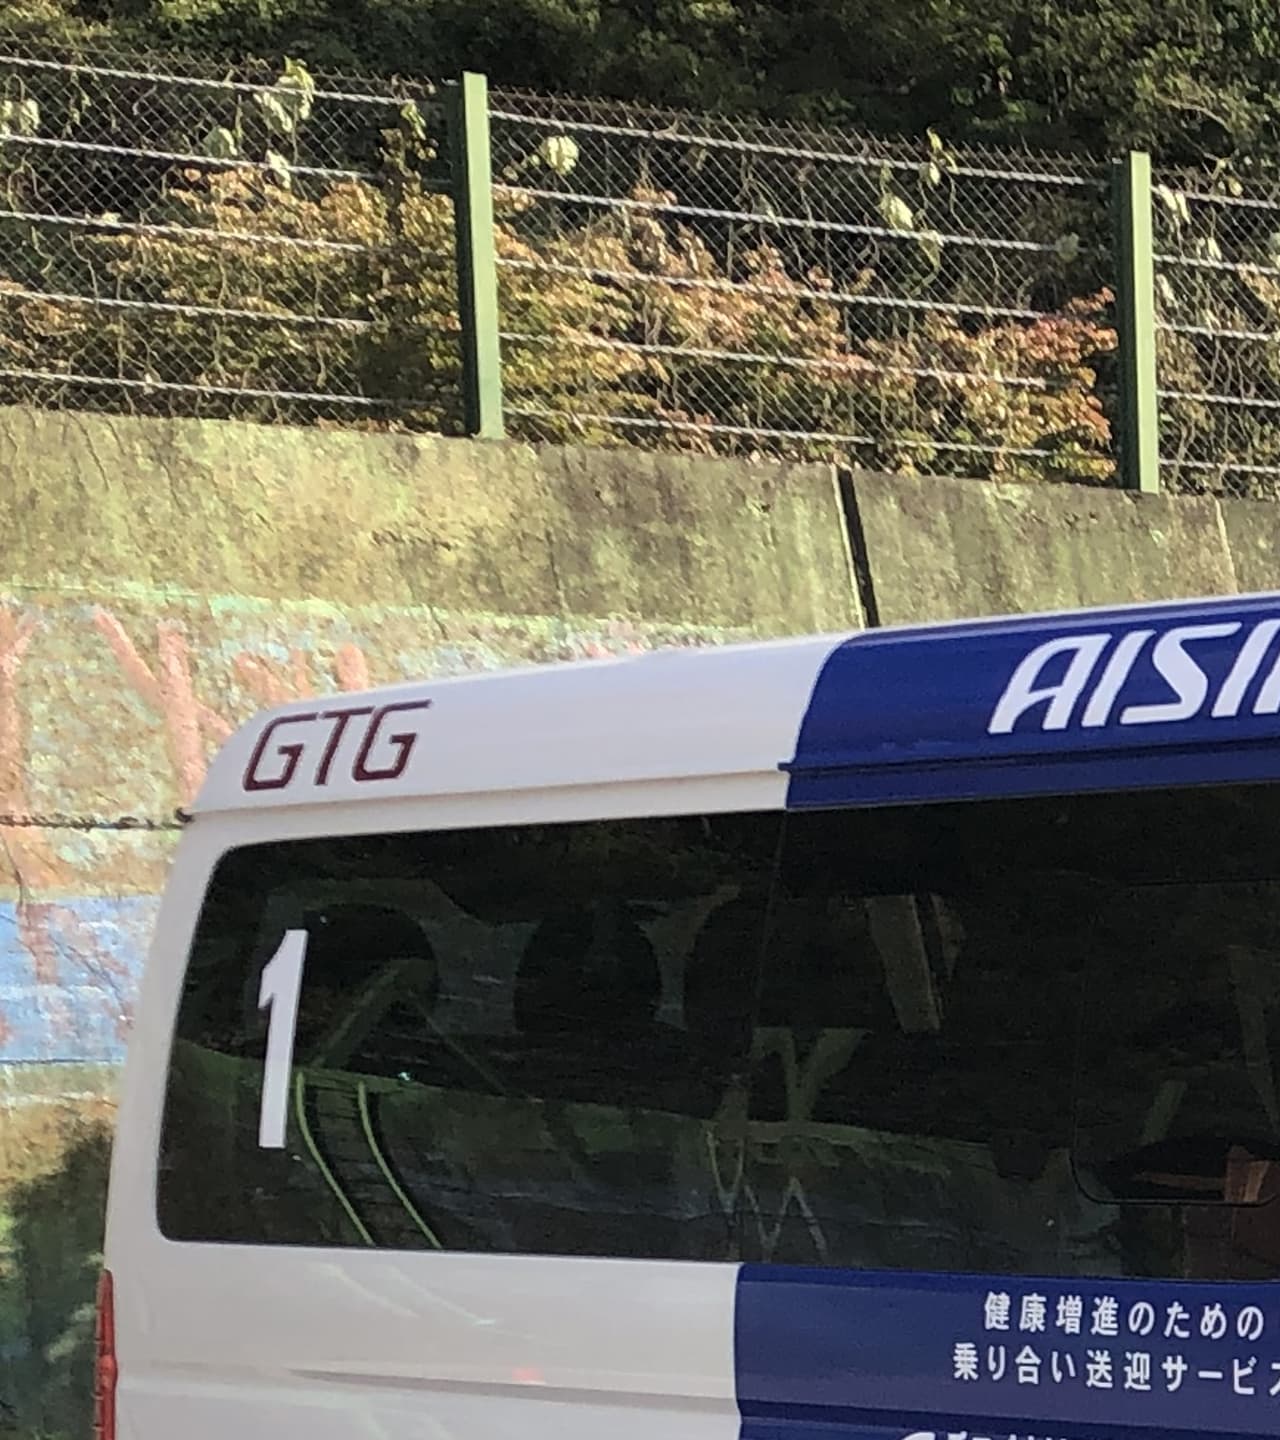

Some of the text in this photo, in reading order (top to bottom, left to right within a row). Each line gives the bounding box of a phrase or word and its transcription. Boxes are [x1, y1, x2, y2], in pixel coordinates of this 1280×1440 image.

[243, 699, 432, 792] GTG
[258, 929, 308, 1149] 1
[984, 1291, 1266, 1346] 健康増進のための
